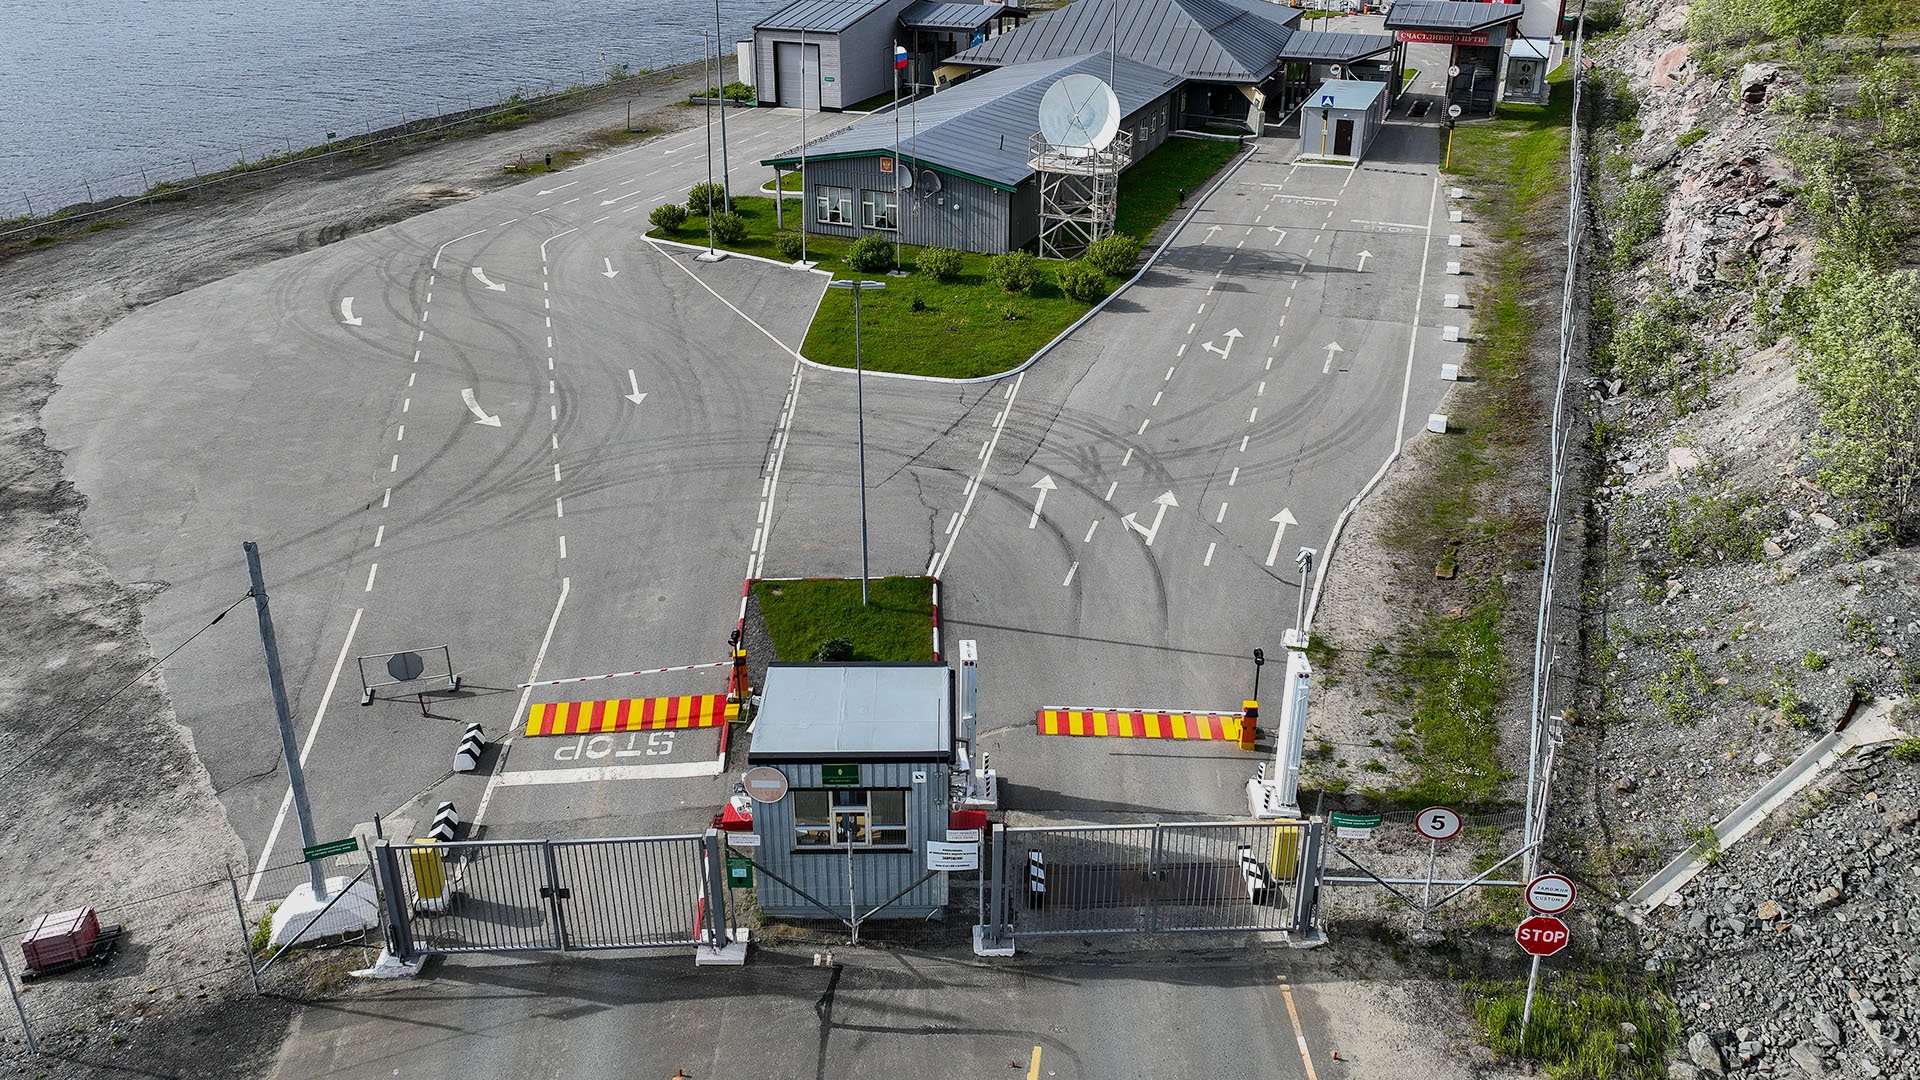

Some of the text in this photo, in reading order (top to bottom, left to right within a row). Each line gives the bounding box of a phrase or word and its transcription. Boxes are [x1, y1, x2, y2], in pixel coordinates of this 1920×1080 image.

[1400, 32, 1487, 43] СЧАСТЛИВОГО ПУТИ!
[554, 731, 676, 761] STOP
[1430, 815, 1446, 830] 5
[1521, 928, 1566, 944] STOP
